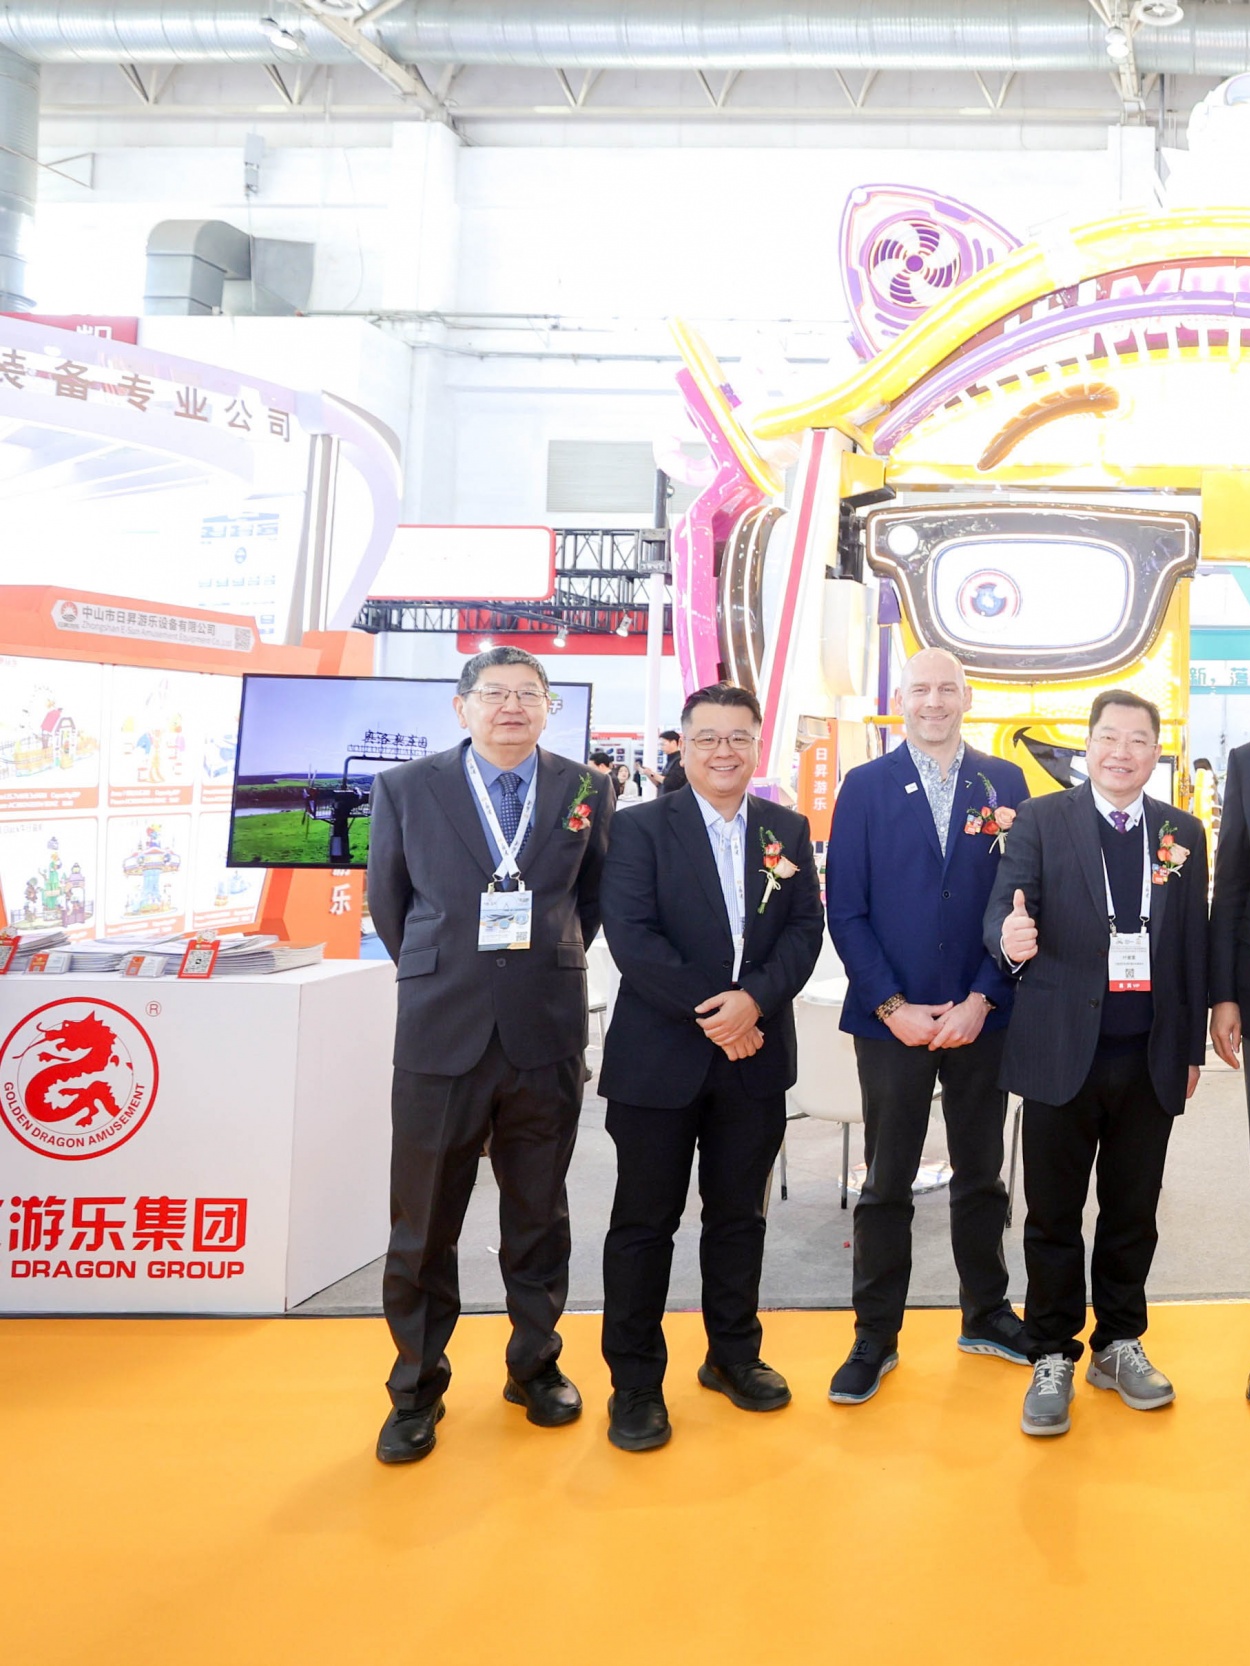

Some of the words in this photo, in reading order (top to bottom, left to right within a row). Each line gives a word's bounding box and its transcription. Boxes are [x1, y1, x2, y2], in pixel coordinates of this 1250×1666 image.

[0, 349, 291, 443] 装备专业公司
[4, 1081, 32, 1131] GOLDEN
[31, 1127, 85, 1148] DRAGON
[88, 1082, 145, 1146] AMUSEMENT
[9, 1195, 248, 1252] 游乐集团
[11, 1260, 136, 1279] DRAGON
[147, 1260, 245, 1279] GROUP
